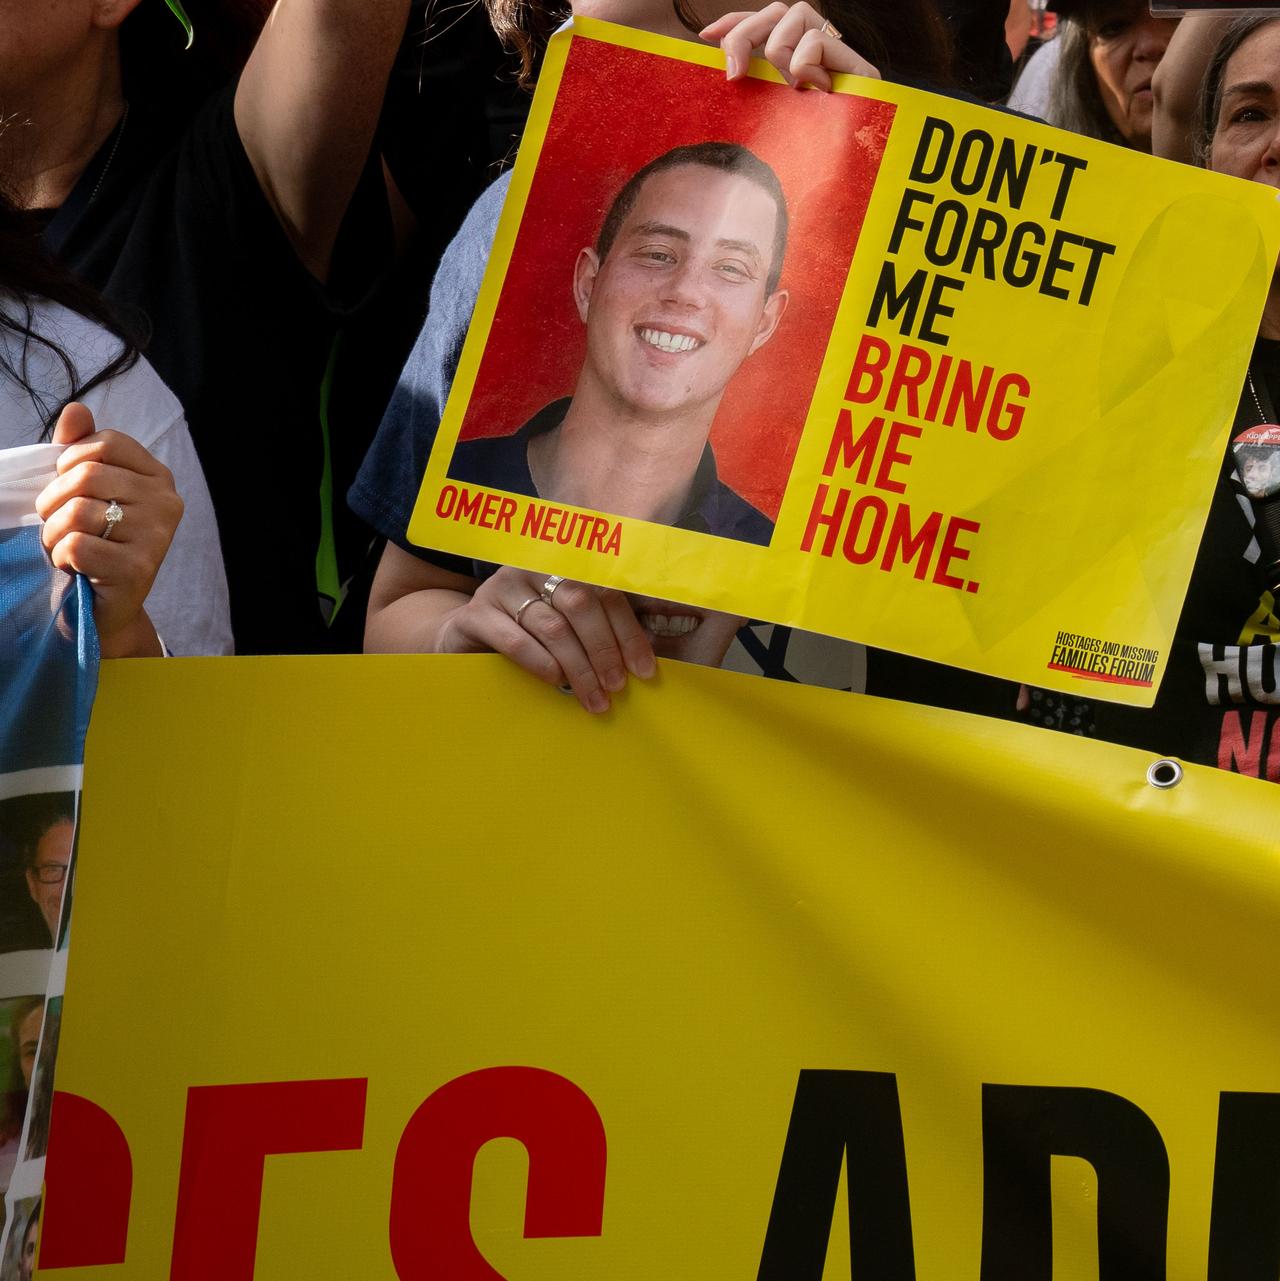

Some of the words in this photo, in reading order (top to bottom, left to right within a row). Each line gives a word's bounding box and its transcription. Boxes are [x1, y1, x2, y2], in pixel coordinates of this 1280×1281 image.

[907, 116, 1089, 223] DON'T
[888, 190, 1117, 308] FORGET
[868, 260, 966, 348] ME
[846, 333, 1032, 443] BRING
[823, 408, 923, 496] ME
[433, 483, 519, 538] OMER
[520, 497, 624, 559] NEUTRA
[798, 485, 981, 595] HOME.
[1050, 645, 1109, 675] FAMILIES
[1108, 657, 1156, 683] FORUM
[1055, 631, 1103, 653] HOSTAGES
[1101, 640, 1121, 656] AND
[1120, 644, 1160, 664] MISSING
